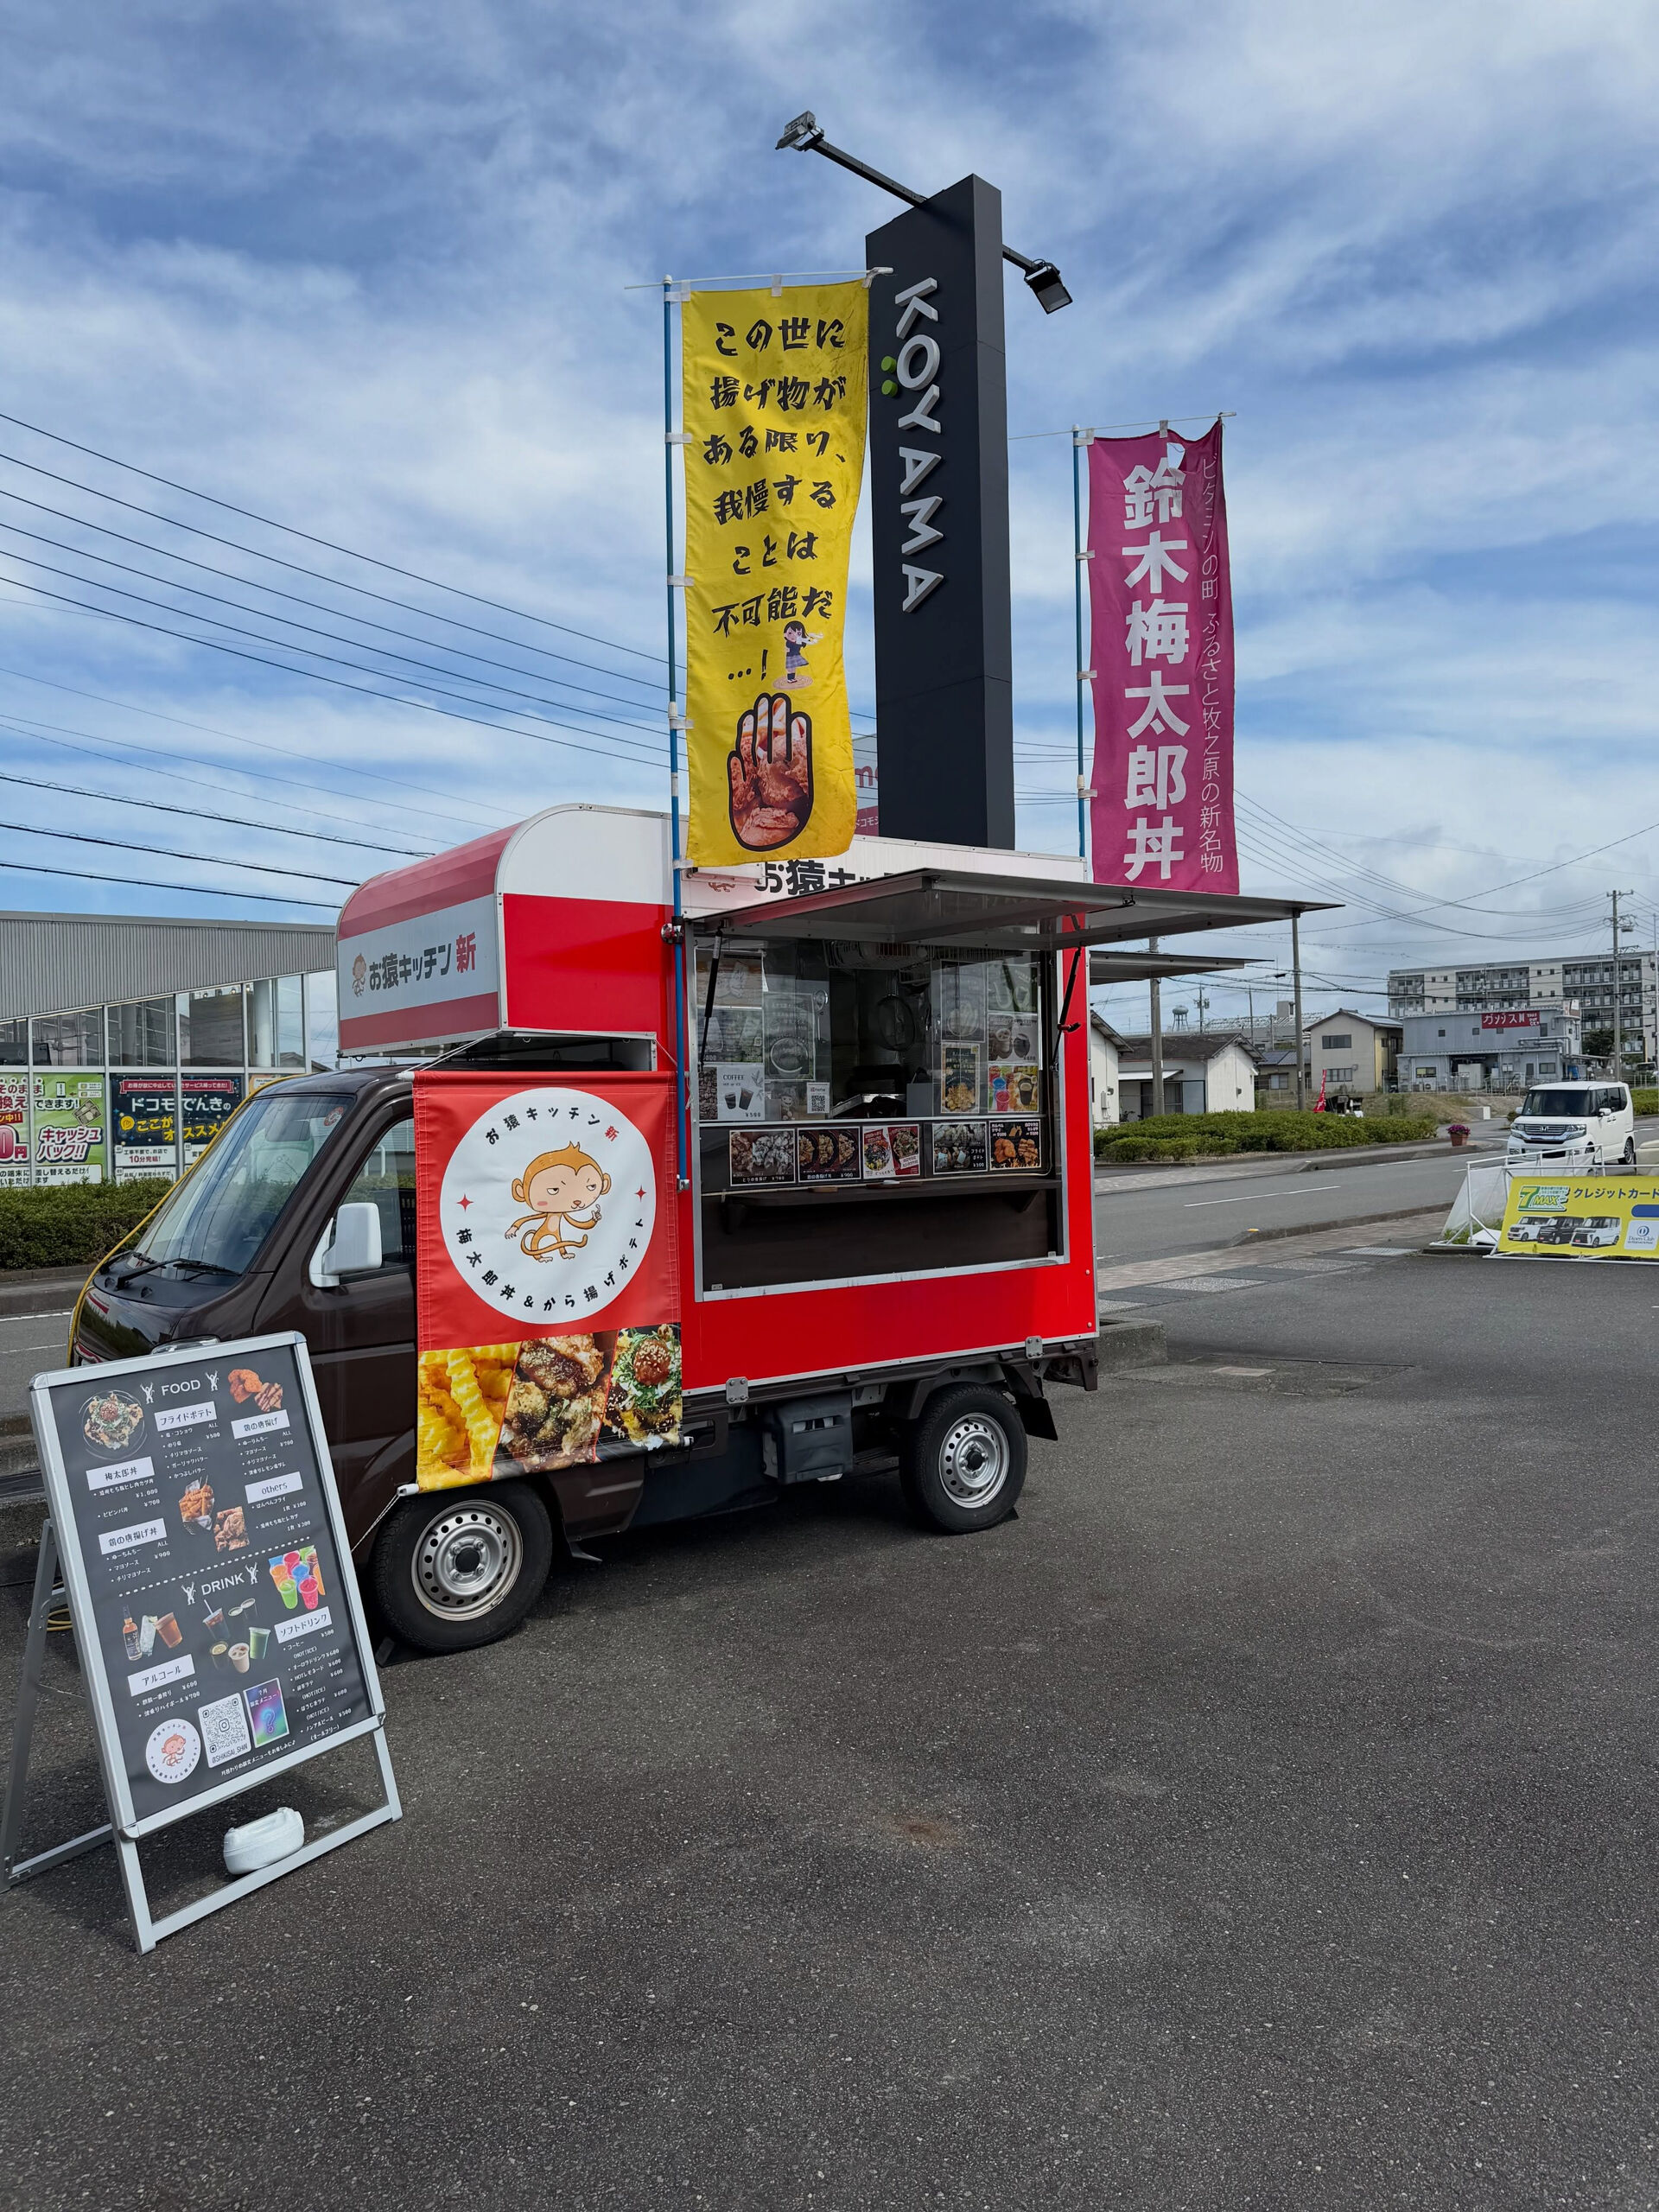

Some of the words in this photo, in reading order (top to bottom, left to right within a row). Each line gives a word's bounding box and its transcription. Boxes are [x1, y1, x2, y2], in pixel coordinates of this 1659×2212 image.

[715, 316, 846, 357] この世に
[709, 376, 847, 411] 揚げ物が
[702, 425, 846, 465] ある限り、
[712, 474, 837, 525] 我慢する
[733, 531, 819, 575] ことは
[711, 586, 834, 639] 不可能だ
[1122, 457, 1191, 881] 鈴木梅太郎丼
[41, 1128, 100, 1142] キャッシュ
[161, 1379, 201, 1396] FOOD
[159, 1408, 213, 1426] フライドポテト
[262, 1481, 288, 1495] others
[201, 1573, 245, 1596] DRINK
[280, 1614, 328, 1637] ソフトドリンク
[142, 1665, 181, 1686] アルコール
